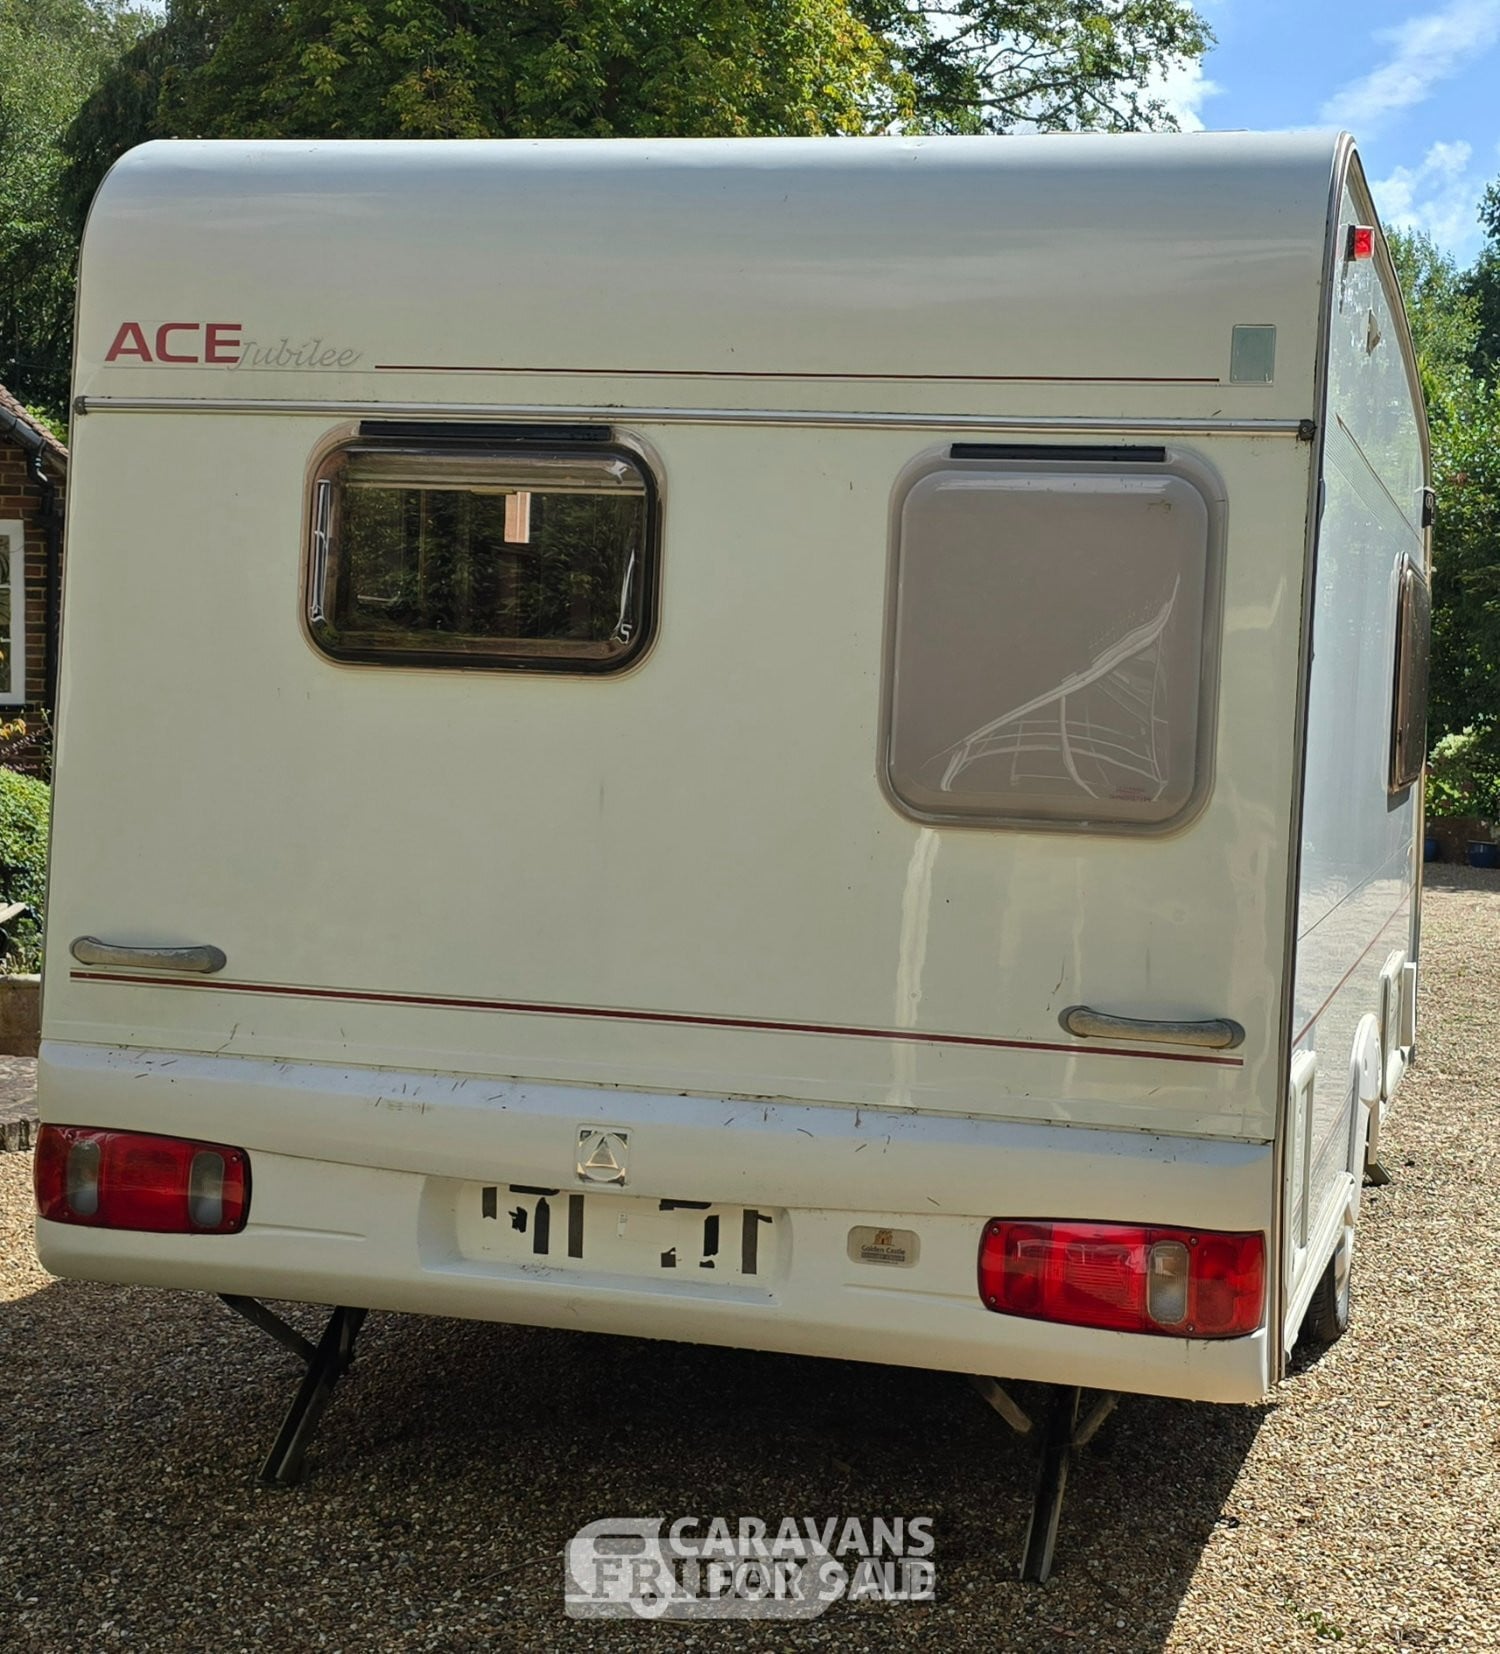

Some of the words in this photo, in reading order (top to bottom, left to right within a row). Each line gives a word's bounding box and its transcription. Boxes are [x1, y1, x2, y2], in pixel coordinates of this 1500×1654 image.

[104, 322, 242, 364] ACE
[227, 338, 363, 371] Jubilee
[861, 1244, 885, 1253] Golden
